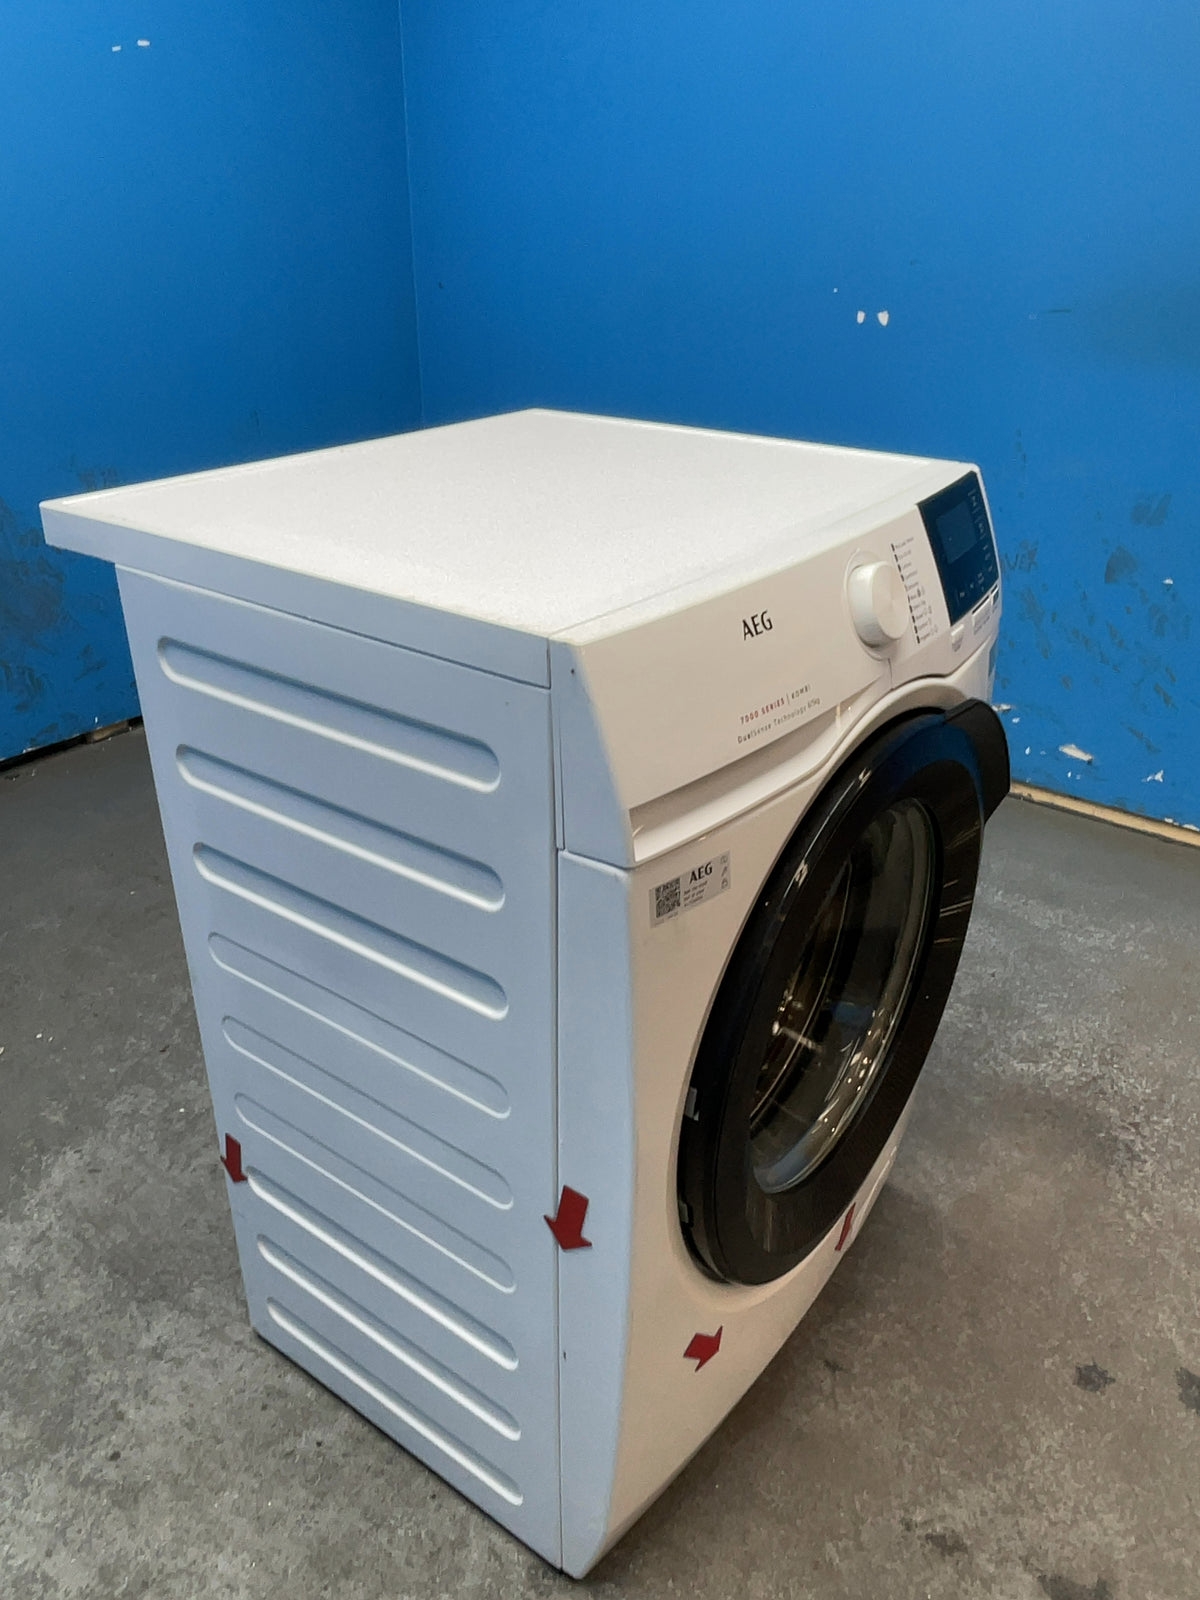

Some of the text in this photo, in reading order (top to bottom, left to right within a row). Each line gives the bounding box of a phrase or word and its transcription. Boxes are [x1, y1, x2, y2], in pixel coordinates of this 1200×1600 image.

[742, 609, 773, 641] AEG
[740, 709, 759, 725] 7000
[761, 697, 785, 715] SERIES
[689, 861, 713, 884] AEG
